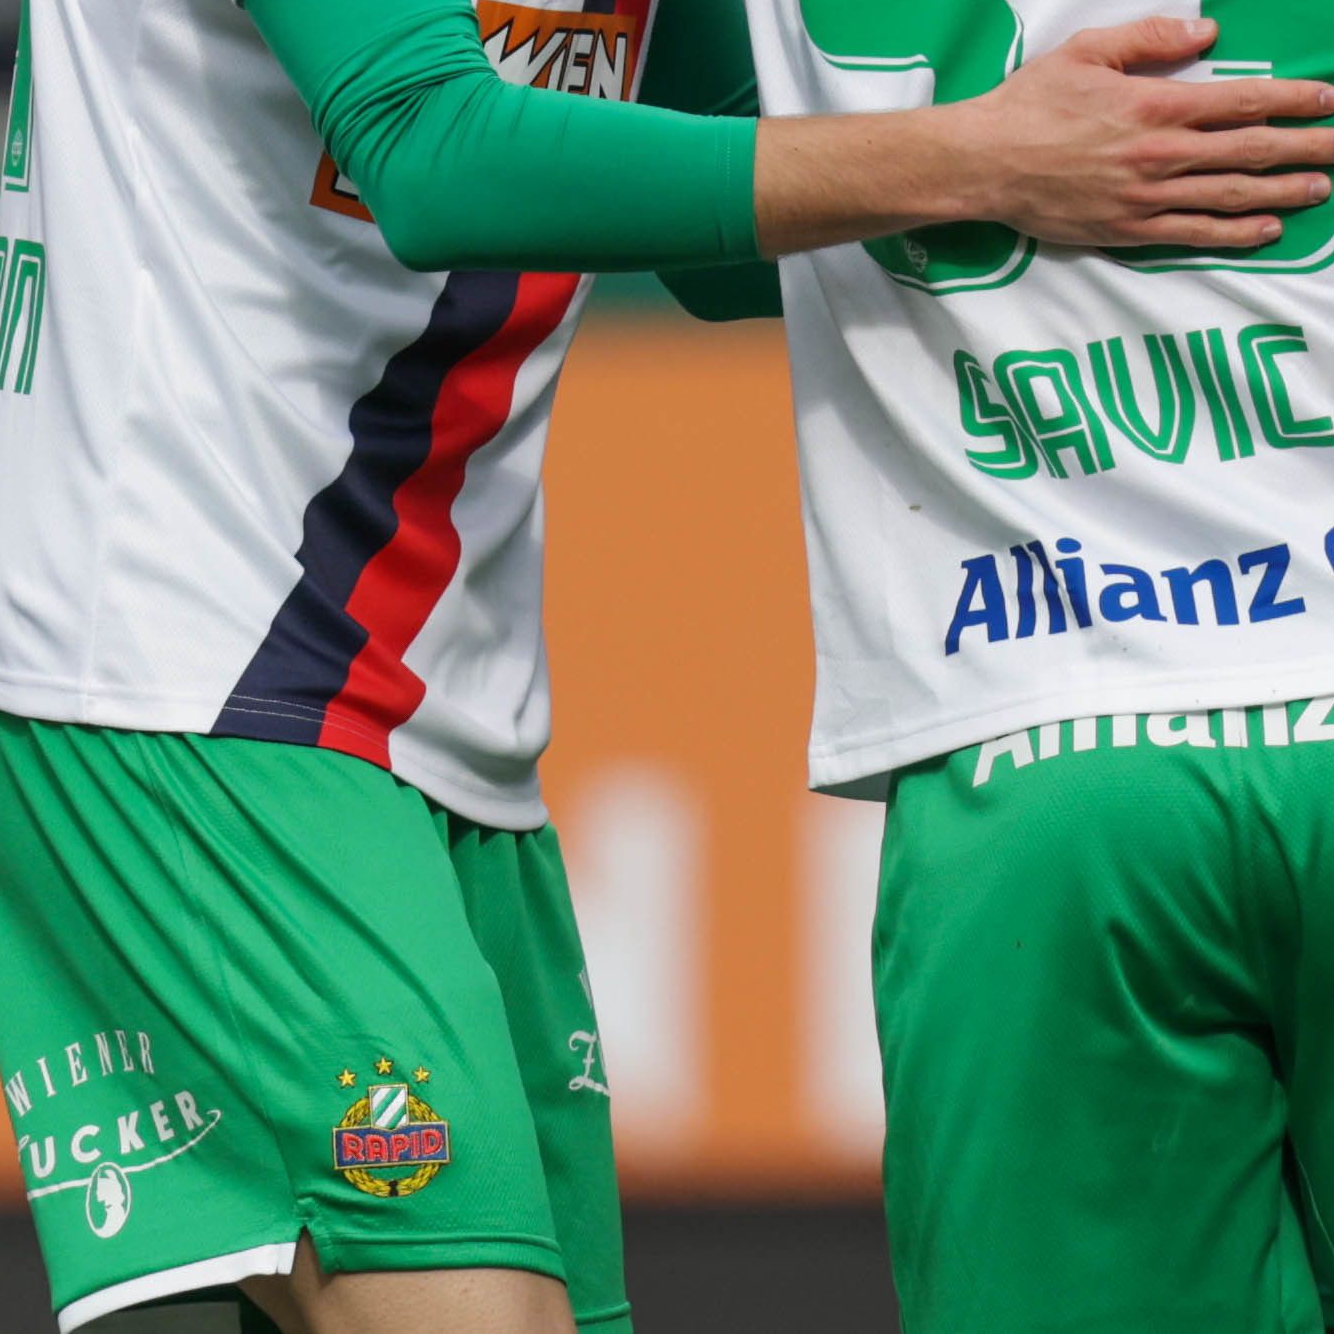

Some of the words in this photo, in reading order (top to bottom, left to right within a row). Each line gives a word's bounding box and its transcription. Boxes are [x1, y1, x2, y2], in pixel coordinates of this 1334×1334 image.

[944, 537, 1307, 657] Allianz
[5, 1029, 155, 1118] WIENER
[18, 1089, 204, 1180] UCKER
[341, 1128, 444, 1162] RAPID
